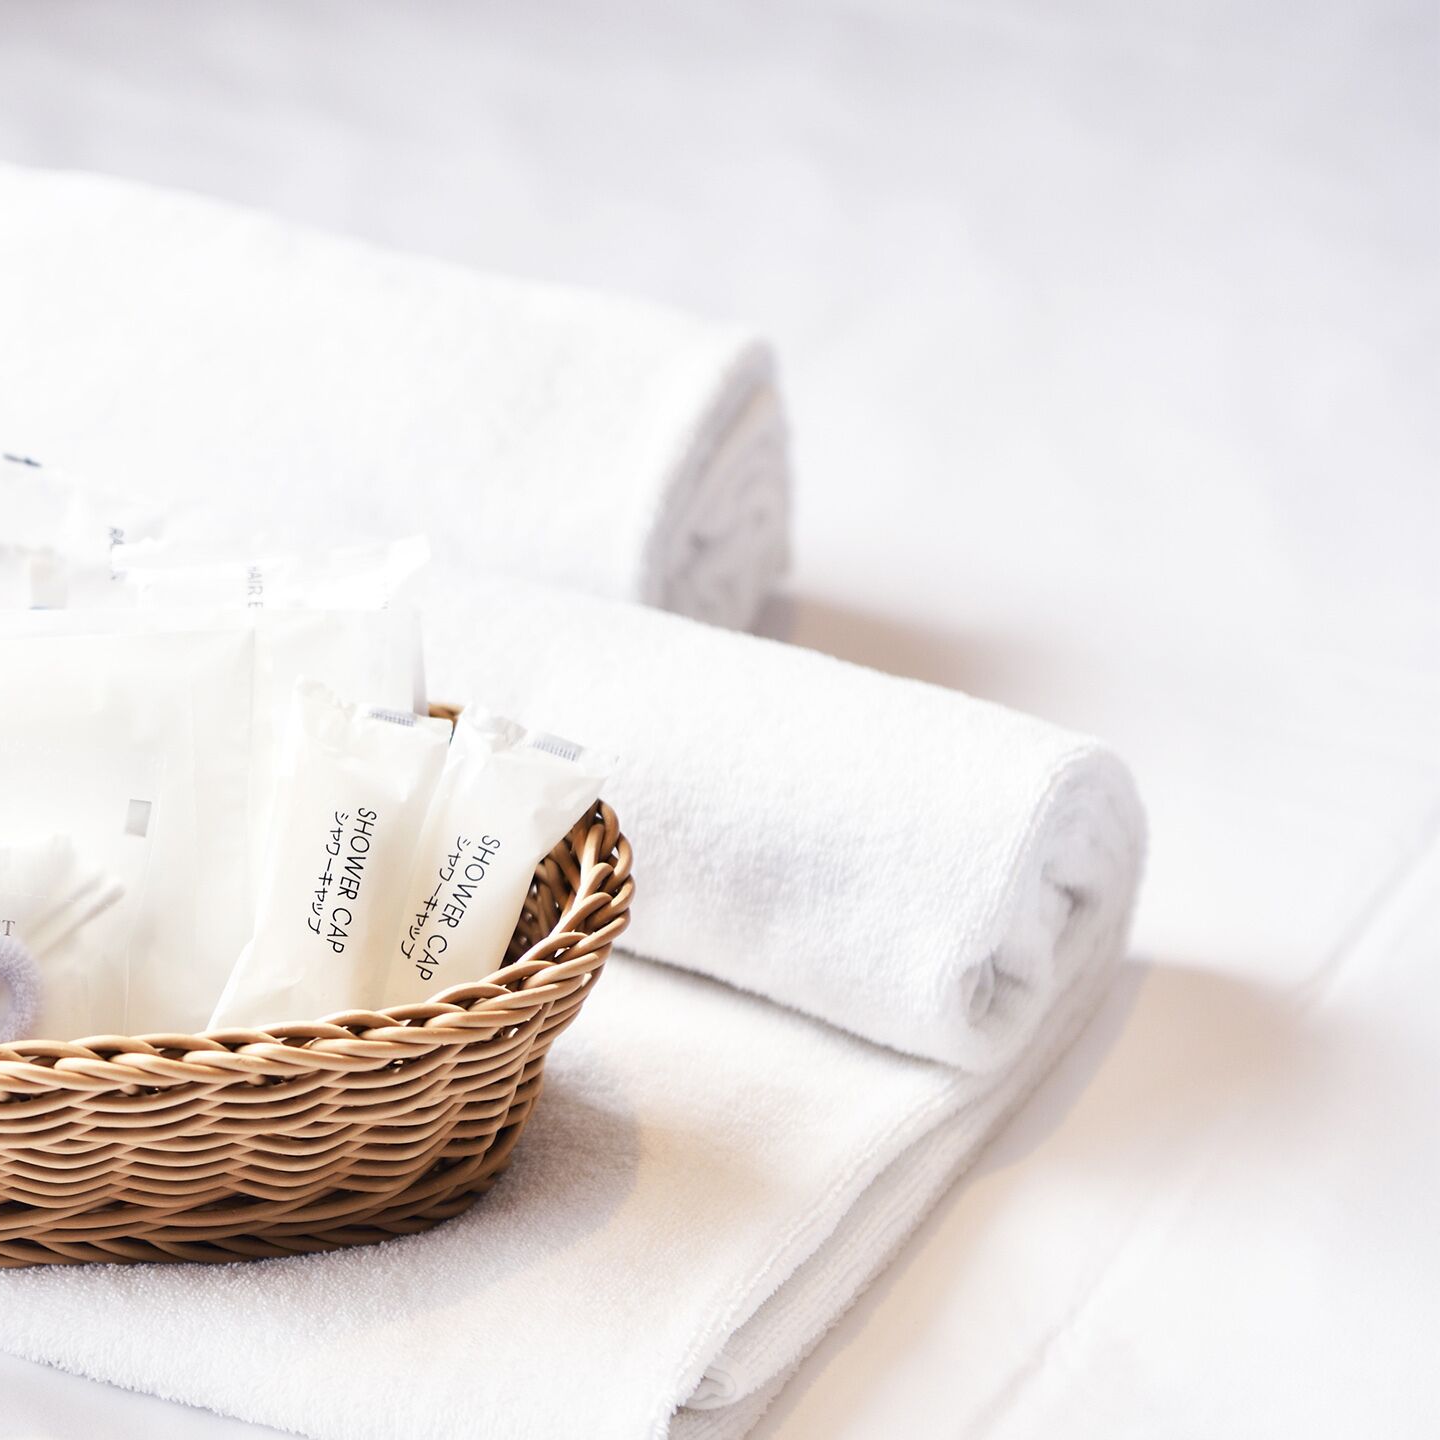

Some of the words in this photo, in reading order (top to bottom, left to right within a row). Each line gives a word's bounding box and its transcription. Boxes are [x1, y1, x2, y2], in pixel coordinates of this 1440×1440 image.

[308, 811, 349, 934] シャワーキャップ
[337, 807, 377, 900] SHOWER
[401, 835, 471, 959] シャワーキャップ
[438, 835, 501, 928] SHOWER
[326, 907, 352, 954] CAP
[415, 934, 448, 981] CAP
